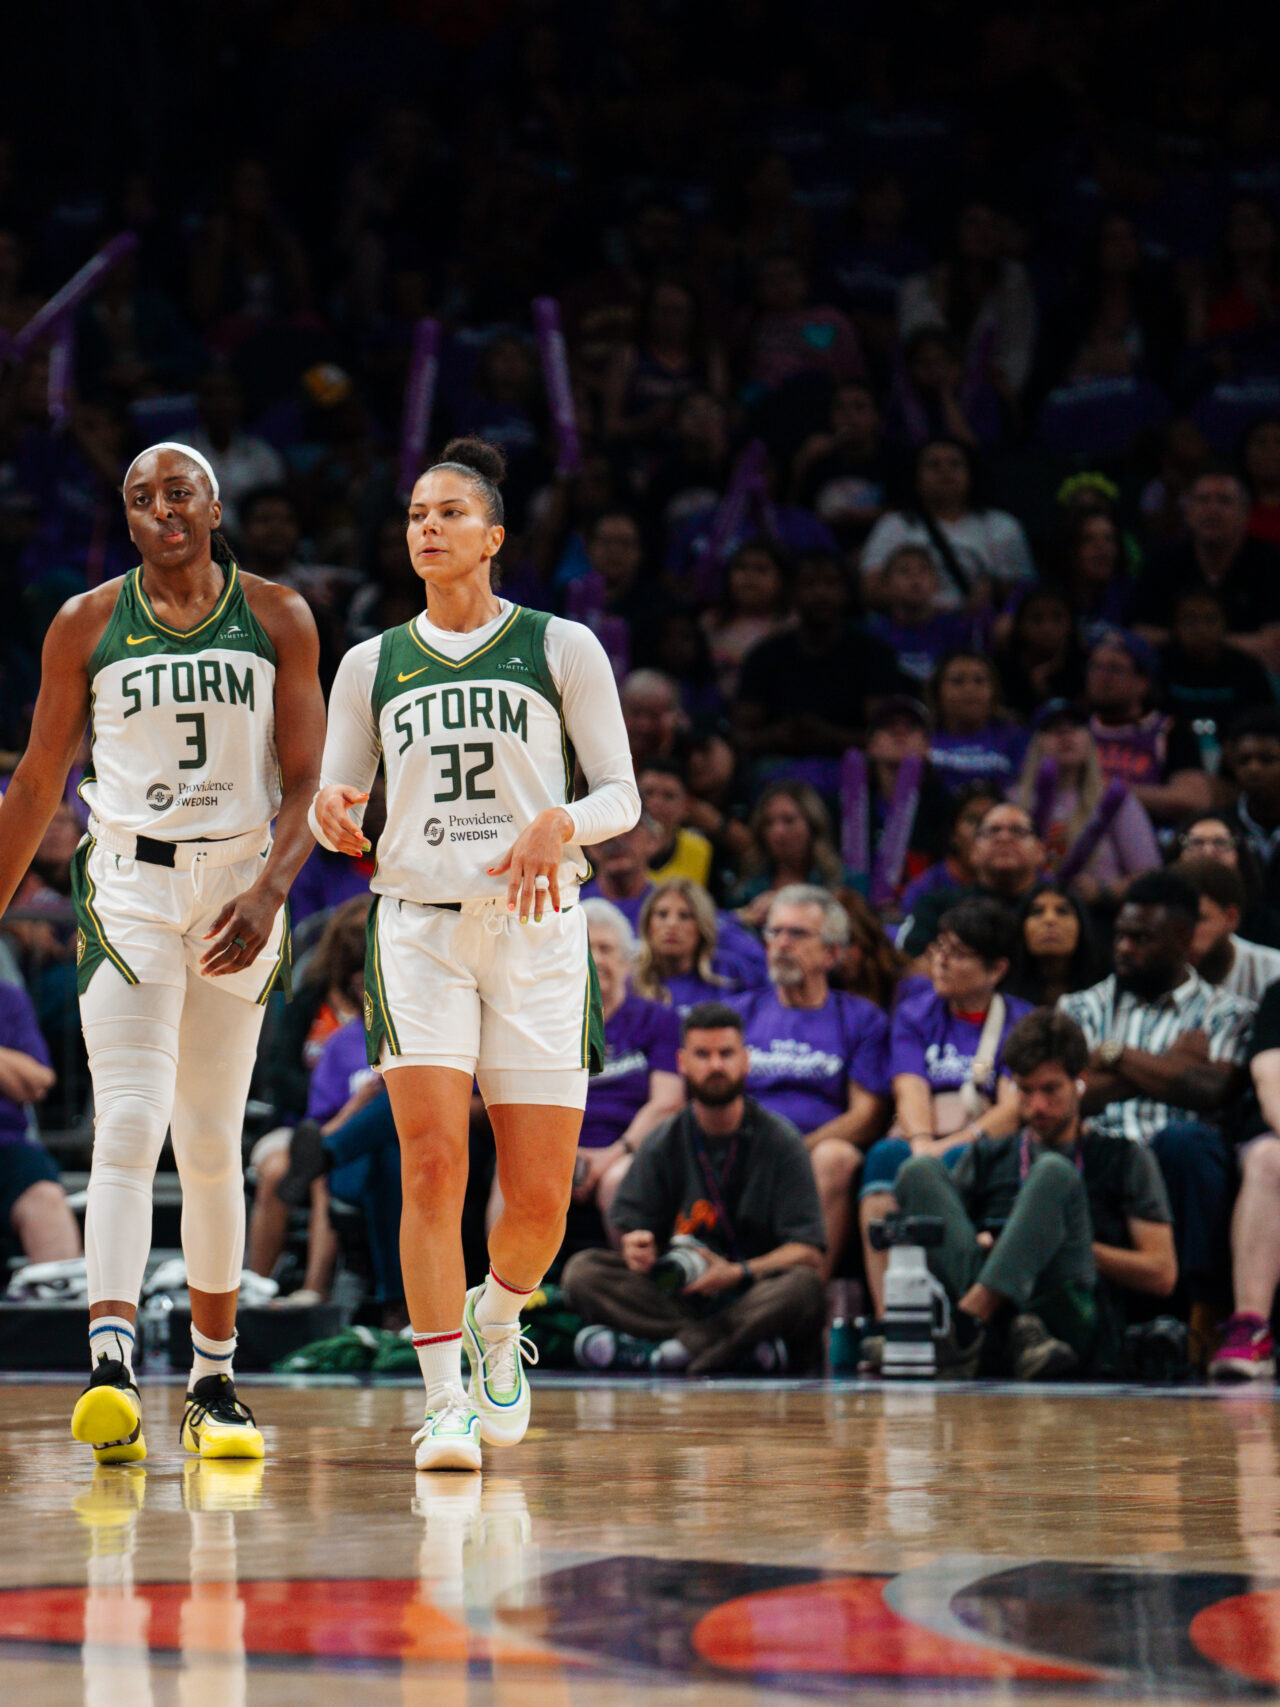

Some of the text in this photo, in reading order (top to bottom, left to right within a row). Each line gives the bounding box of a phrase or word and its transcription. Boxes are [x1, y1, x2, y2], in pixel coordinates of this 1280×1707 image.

[497, 663, 529, 672] SYMETRA
[122, 660, 254, 719] STORM
[394, 687, 527, 756] STORM
[176, 713, 207, 769] 3
[430, 742, 496, 803] 32
[178, 781, 234, 795] Providence
[175, 797, 218, 807] SWEDISH
[449, 813, 514, 827] Providence
[450, 829, 498, 842] SWEDISH
